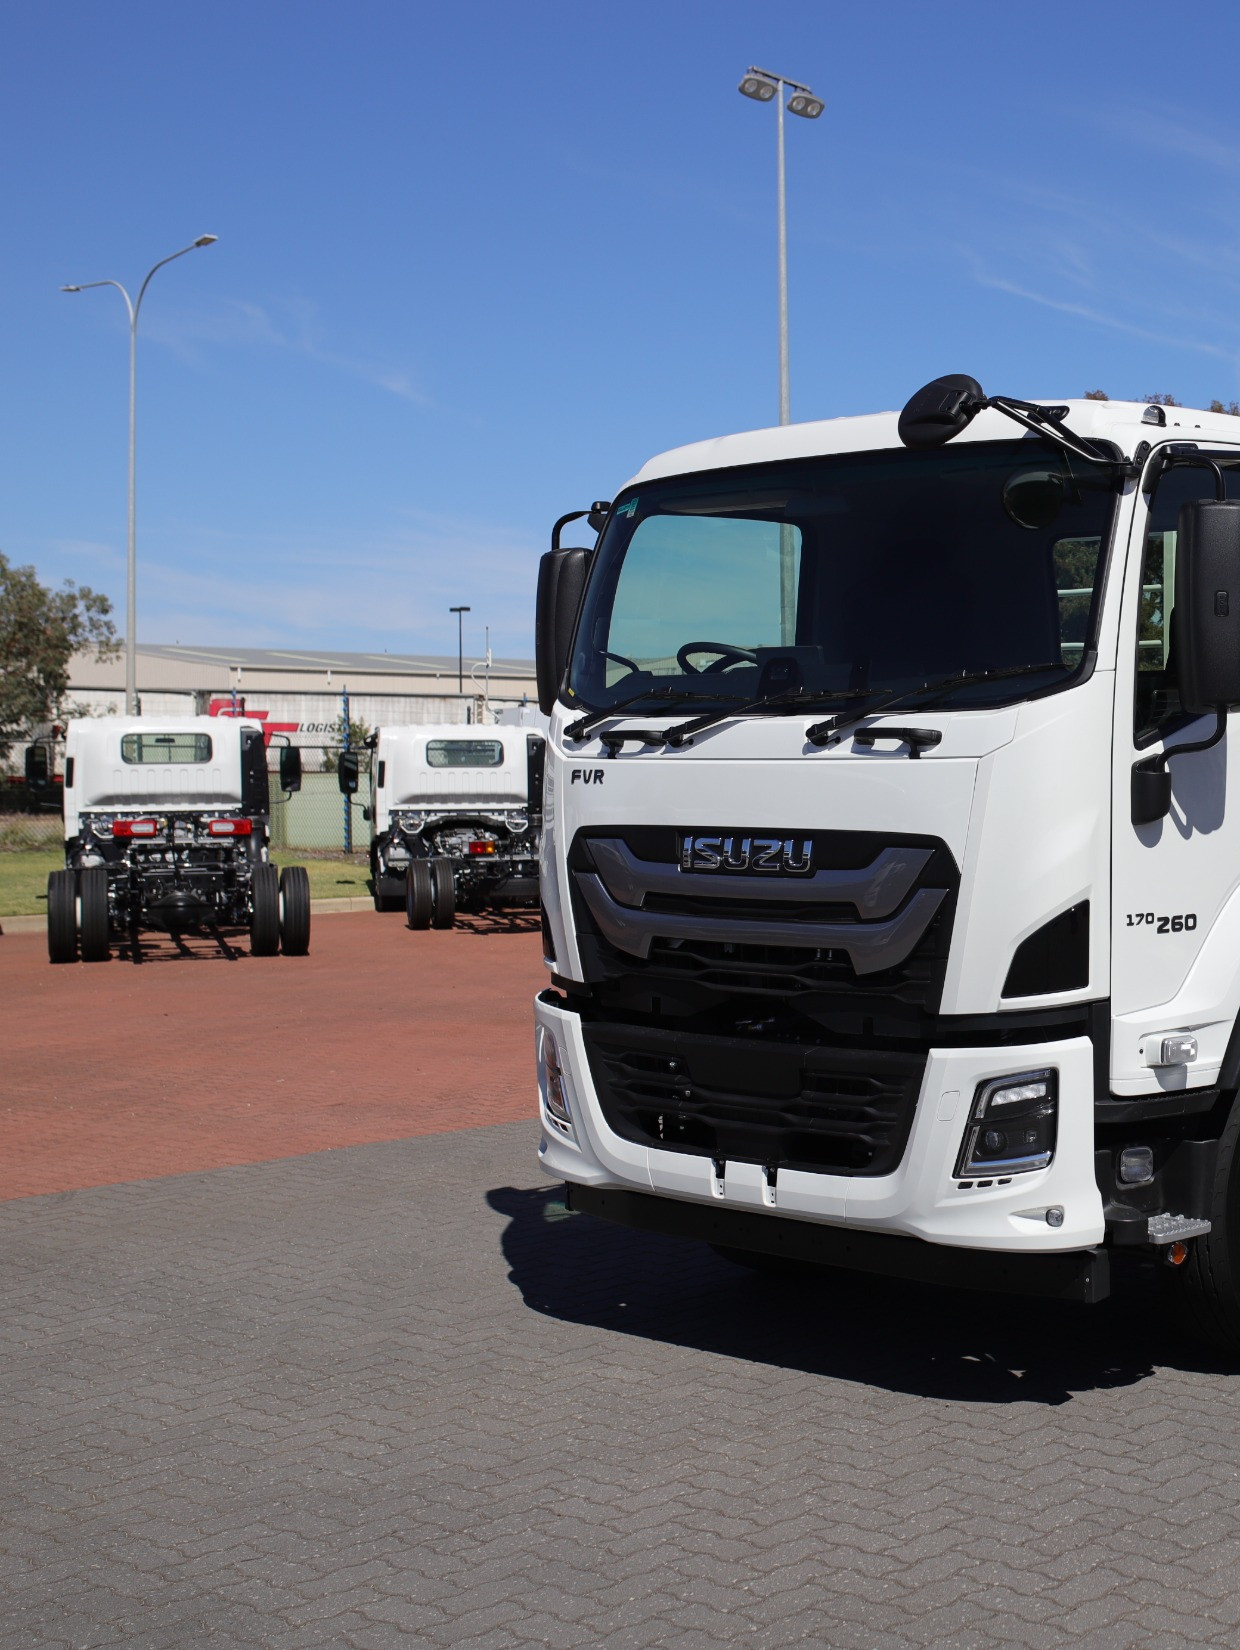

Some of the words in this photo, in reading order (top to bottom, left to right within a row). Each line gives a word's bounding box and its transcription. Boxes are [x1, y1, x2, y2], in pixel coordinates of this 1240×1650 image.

[571, 769, 605, 785] FVR
[682, 836, 813, 873] ISUZU
[1156, 913, 1197, 934] 260
